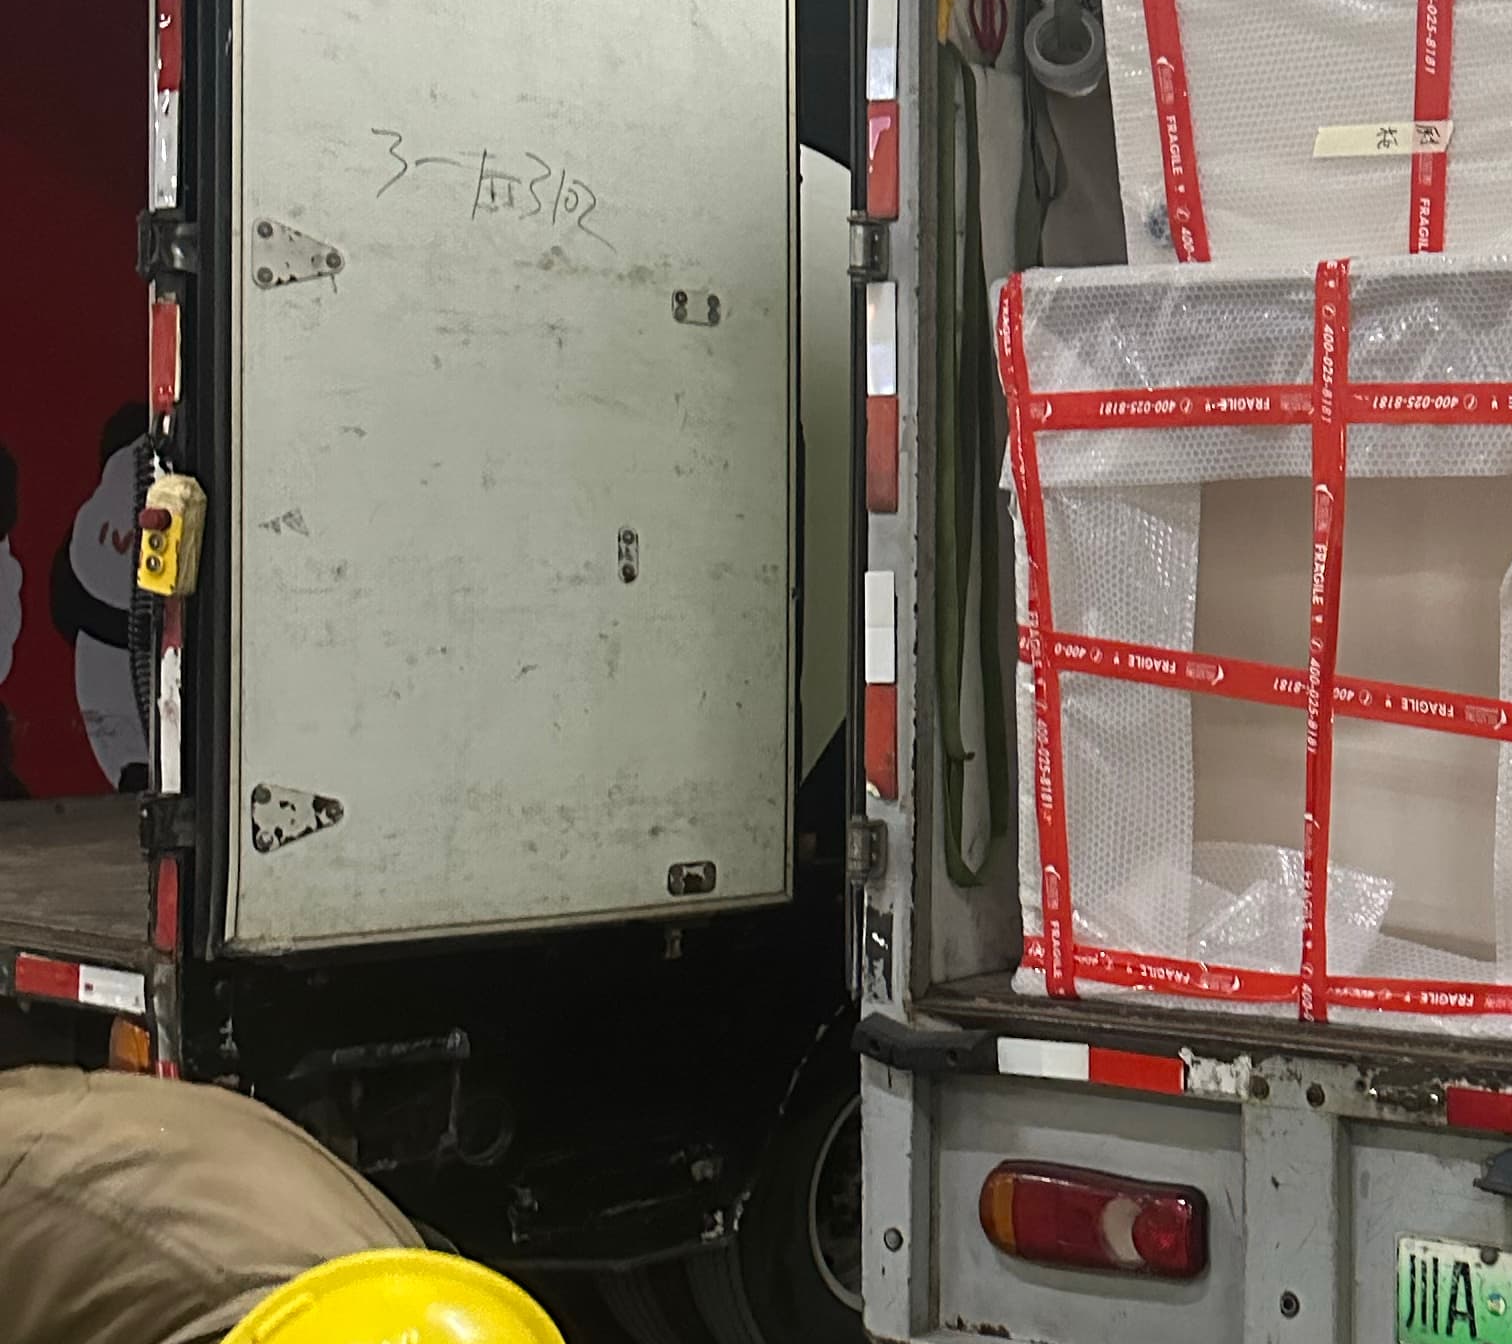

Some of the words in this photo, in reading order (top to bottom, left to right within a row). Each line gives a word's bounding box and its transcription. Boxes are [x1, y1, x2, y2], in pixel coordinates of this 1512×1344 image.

[1166, 115, 1183, 176] FRAGILE
[1322, 324, 1334, 424] 400-025-8181
[1100, 400, 1176, 414] 400-025-8181
[1219, 396, 1270, 412] FRAGILE
[1372, 395, 1459, 409] 400-025-8181
[1312, 544, 1326, 605] FRAGILE
[1128, 654, 1177, 674] FRAGILE
[1307, 658, 1320, 753] 400-025-8181
[1401, 697, 1454, 717] FRAGILE
[1037, 719, 1052, 809] 400-025-8181
[1050, 920, 1062, 978] FRAGILE
[1420, 992, 1474, 1006] FRAGILE
